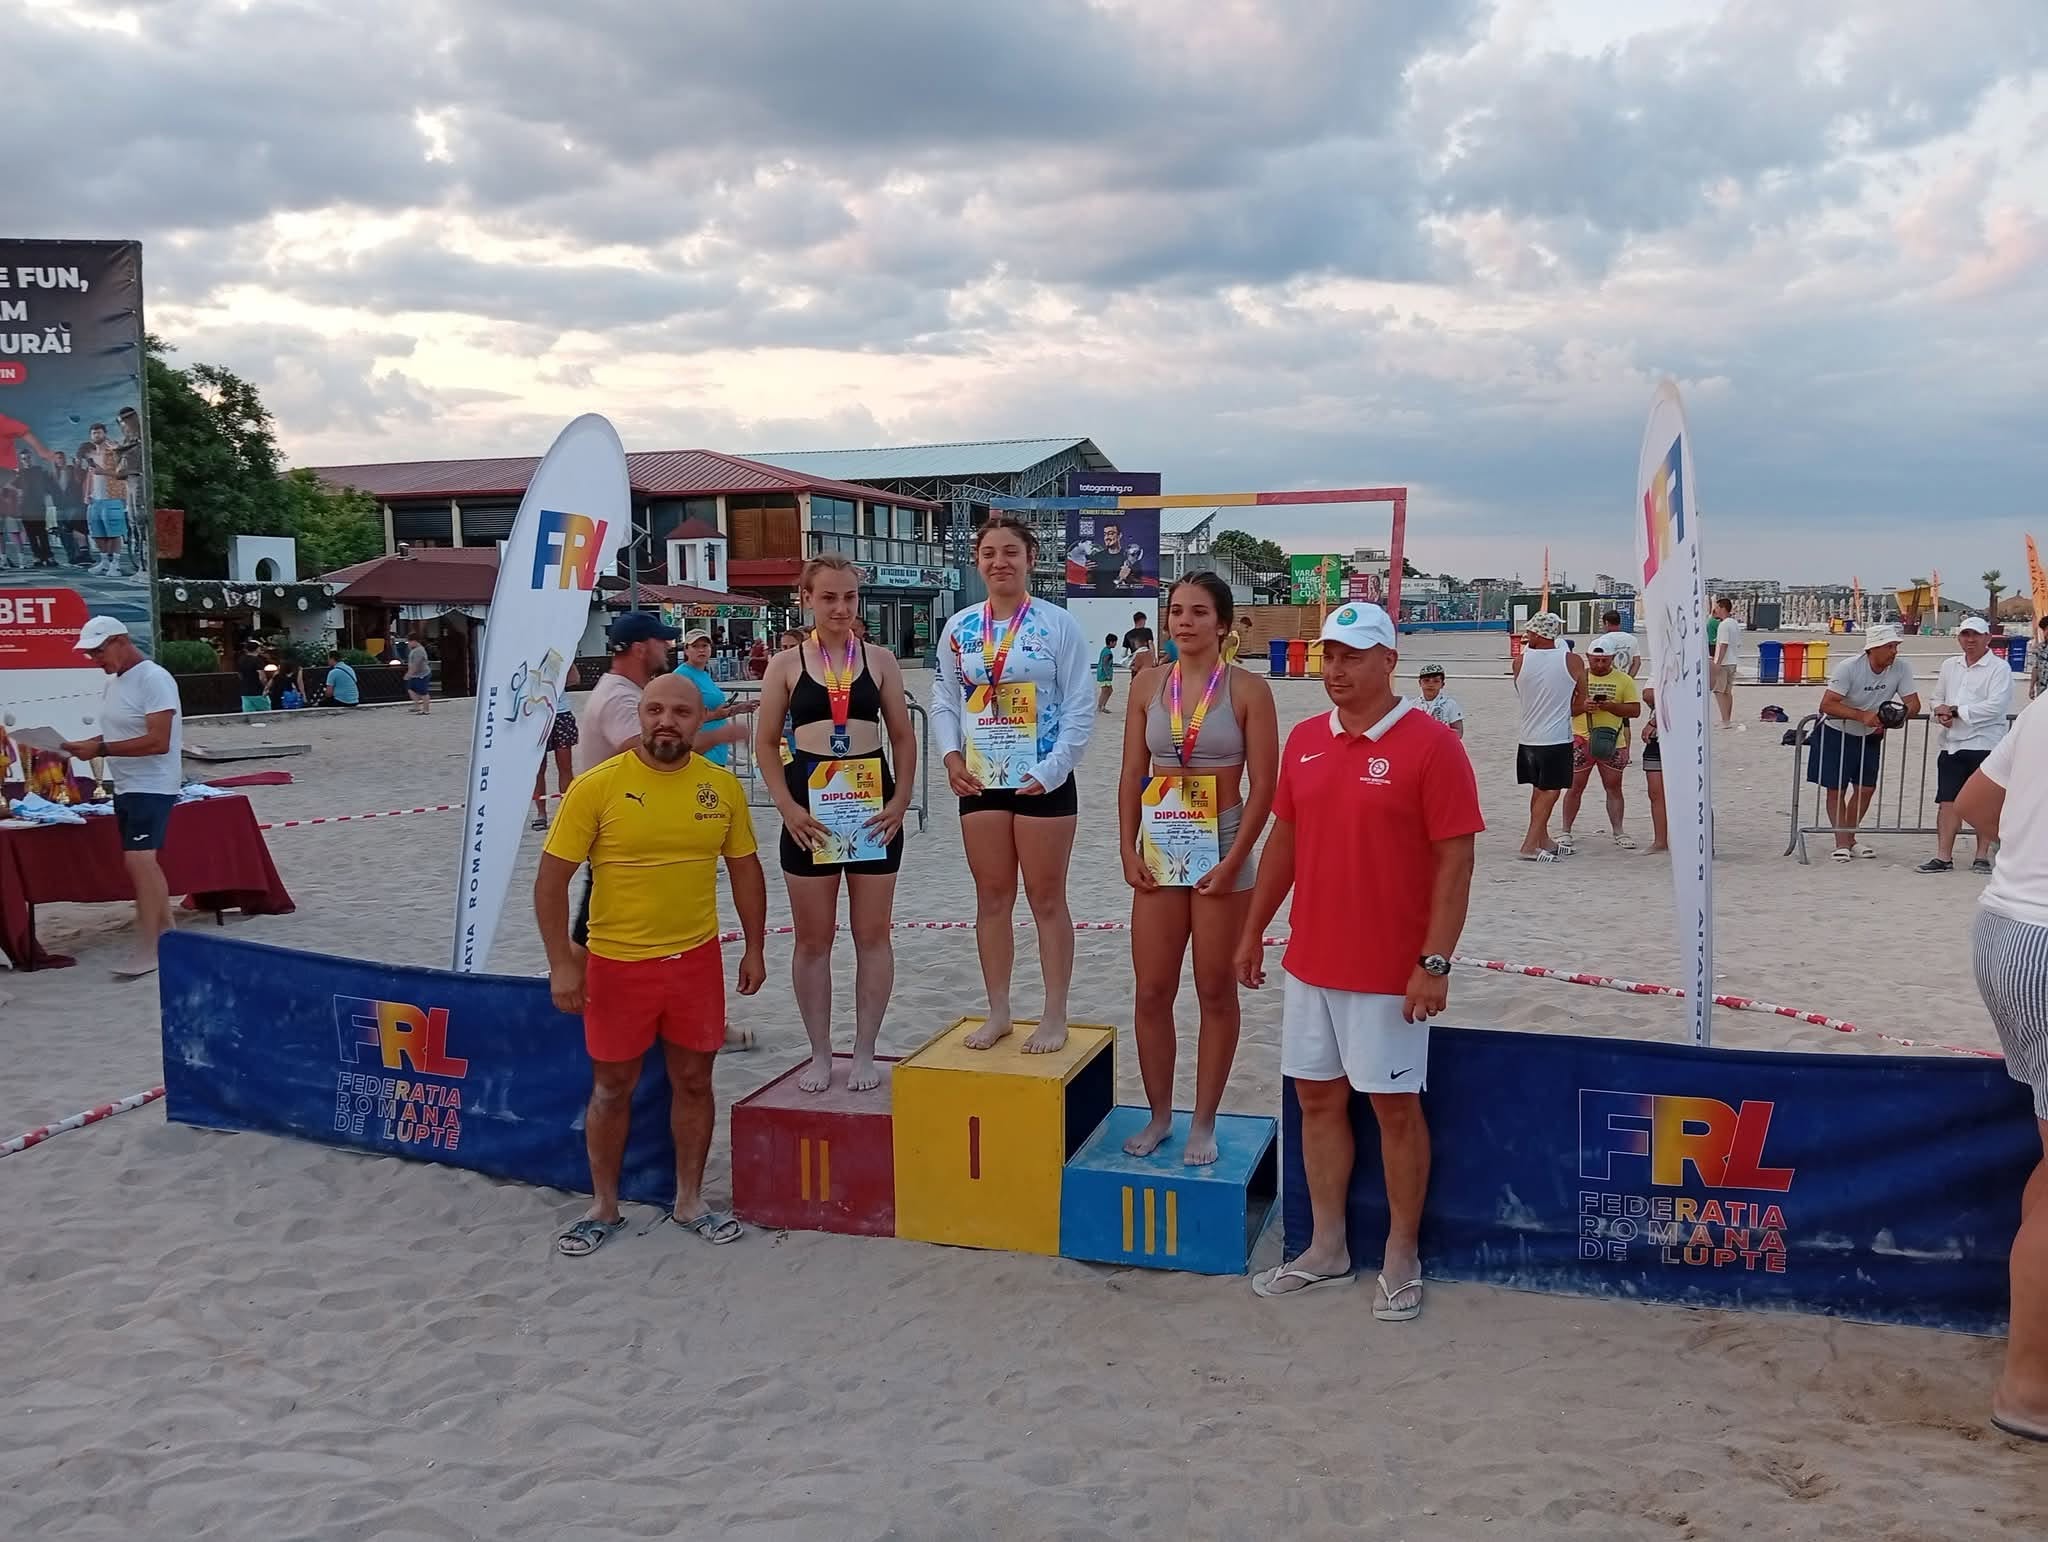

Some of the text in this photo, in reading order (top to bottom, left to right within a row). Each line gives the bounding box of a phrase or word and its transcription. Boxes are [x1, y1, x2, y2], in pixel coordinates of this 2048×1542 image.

[16, 267, 89, 293] FUN,
[0, 300, 28, 321] M
[0, 327, 72, 354] URĂ!
[1079, 484, 1134, 494] totogaming.ro
[531, 509, 609, 591] FRL
[1294, 569, 1316, 577] VARA
[0, 597, 57, 625] BET
[484, 685, 498, 749] LUPTE
[978, 716, 1025, 726] DIPLOMA
[479, 766, 490, 791] DE
[821, 790, 871, 802] DIPLOMA
[1154, 810, 1205, 820] DIPLOMA
[469, 804, 486, 908] ROMANA
[333, 993, 469, 1079] FRL
[337, 1071, 461, 1110] FEDERATIA
[336, 1091, 461, 1130] ROMANA
[334, 1111, 460, 1151] DE LUPTE
[1579, 1088, 1796, 1193] FRL
[800, 1137, 831, 1202] II
[1121, 1185, 1177, 1257] III
[1579, 1190, 1788, 1230] FEDERATIA
[1579, 1214, 1786, 1253] ROMANA
[1578, 1236, 1787, 1274] DE LUPTE
